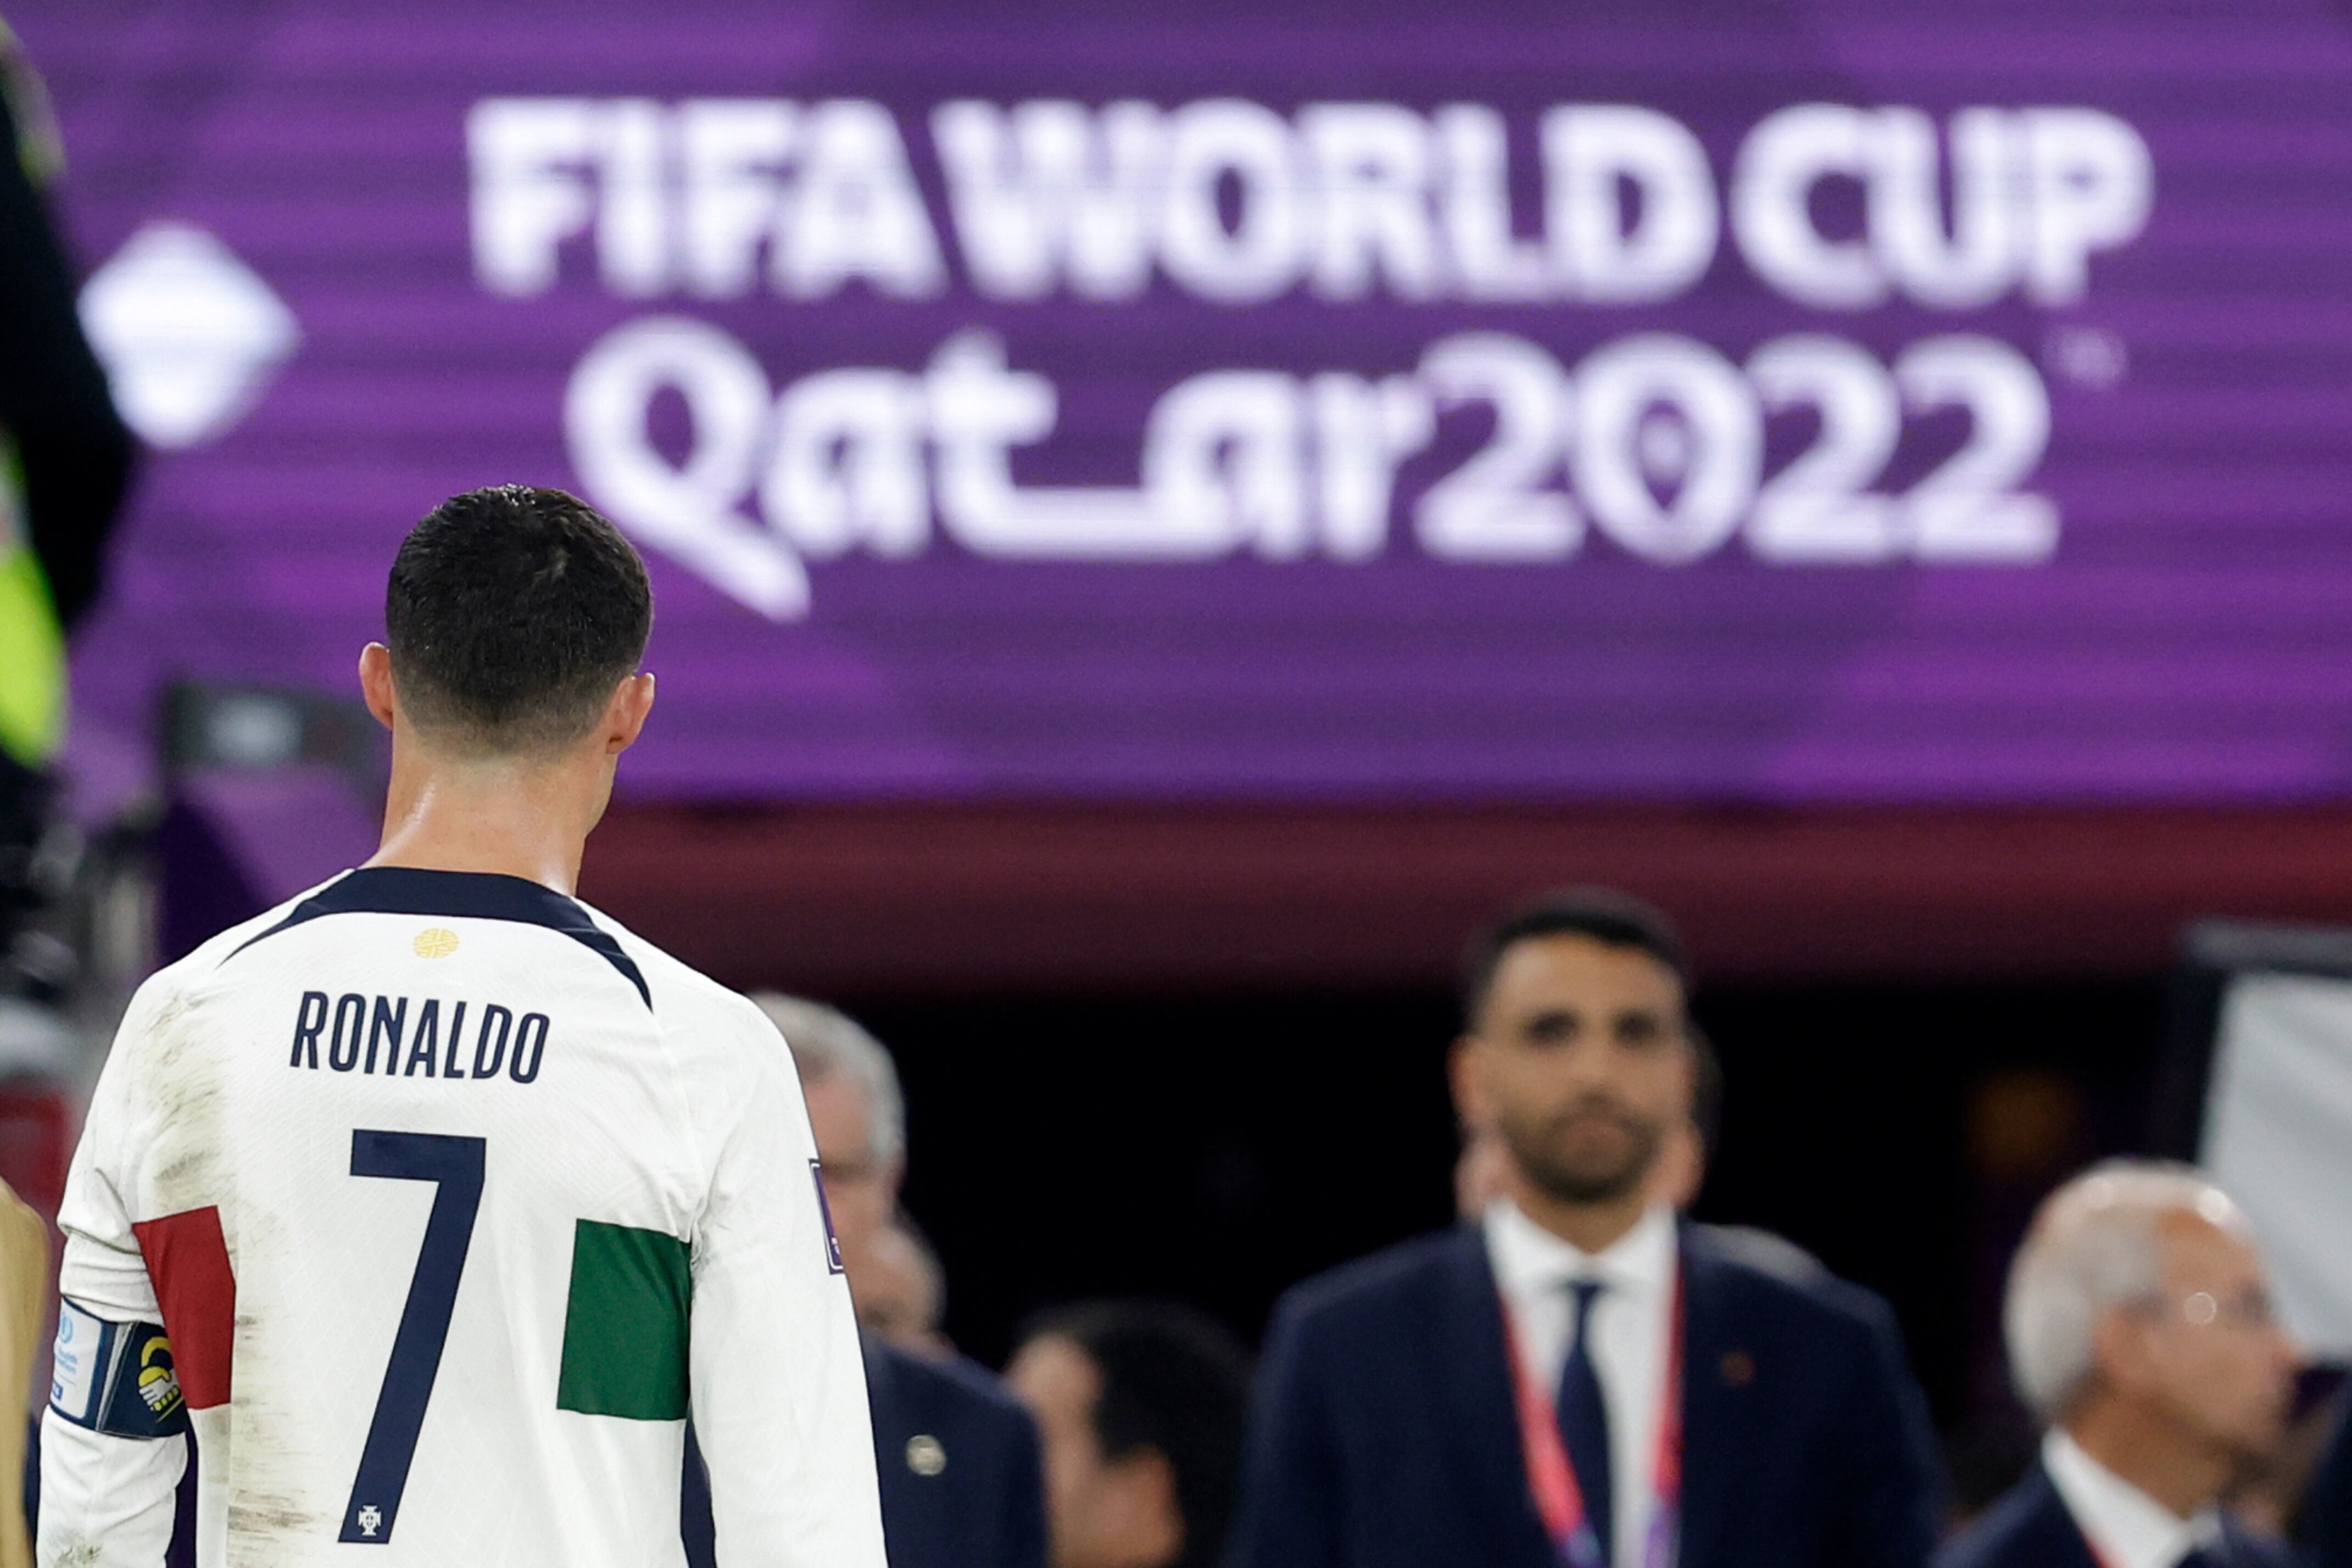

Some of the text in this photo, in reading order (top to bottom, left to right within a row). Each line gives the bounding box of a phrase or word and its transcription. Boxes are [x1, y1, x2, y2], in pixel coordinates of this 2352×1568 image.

[467, 98, 2153, 306] FIFA WORLD CUP
[565, 317, 2058, 617] Qatar 2022
[290, 991, 550, 1084] RONALDO
[337, 1129, 487, 1544] 7
